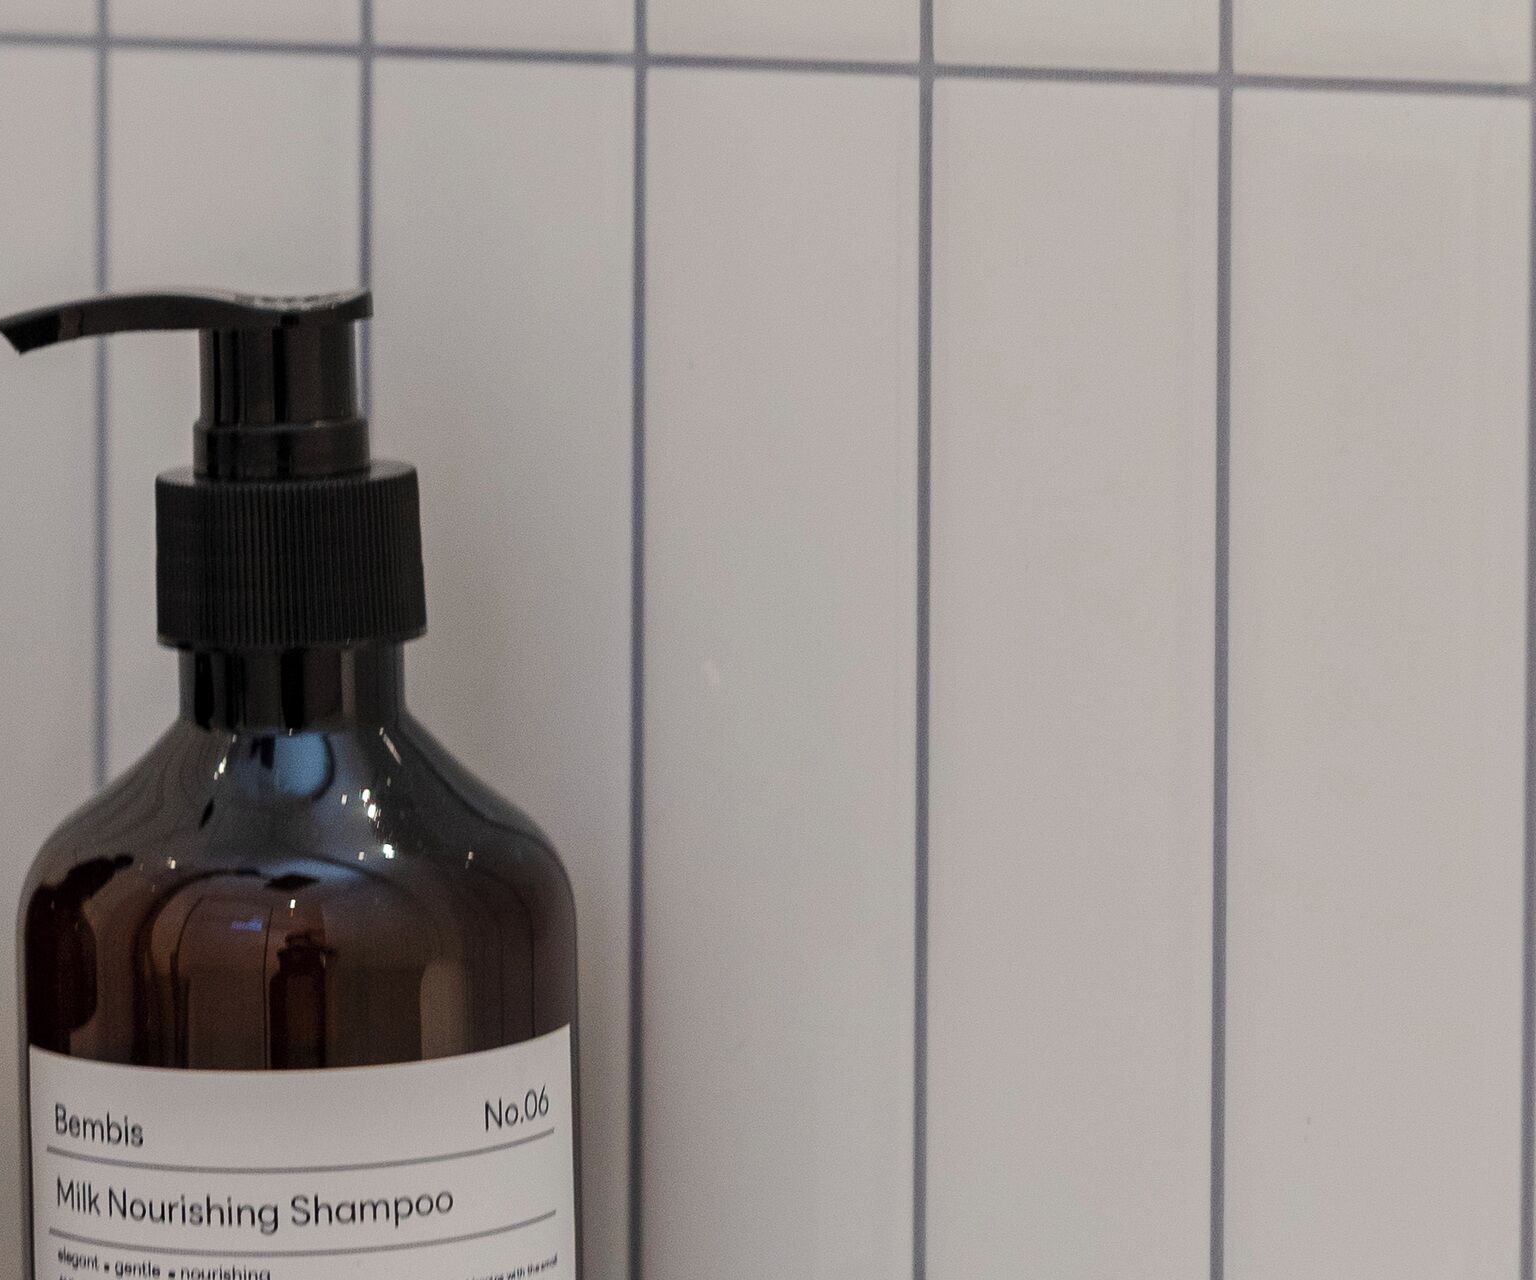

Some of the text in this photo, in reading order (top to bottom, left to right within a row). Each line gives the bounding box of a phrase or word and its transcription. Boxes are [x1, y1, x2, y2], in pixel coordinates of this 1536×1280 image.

[54, 1102, 144, 1147] Bembis
[484, 1084, 549, 1132] No.06
[56, 1175, 454, 1235] Milk Nourishing Shampoo
[114, 1261, 161, 1278] gentle
